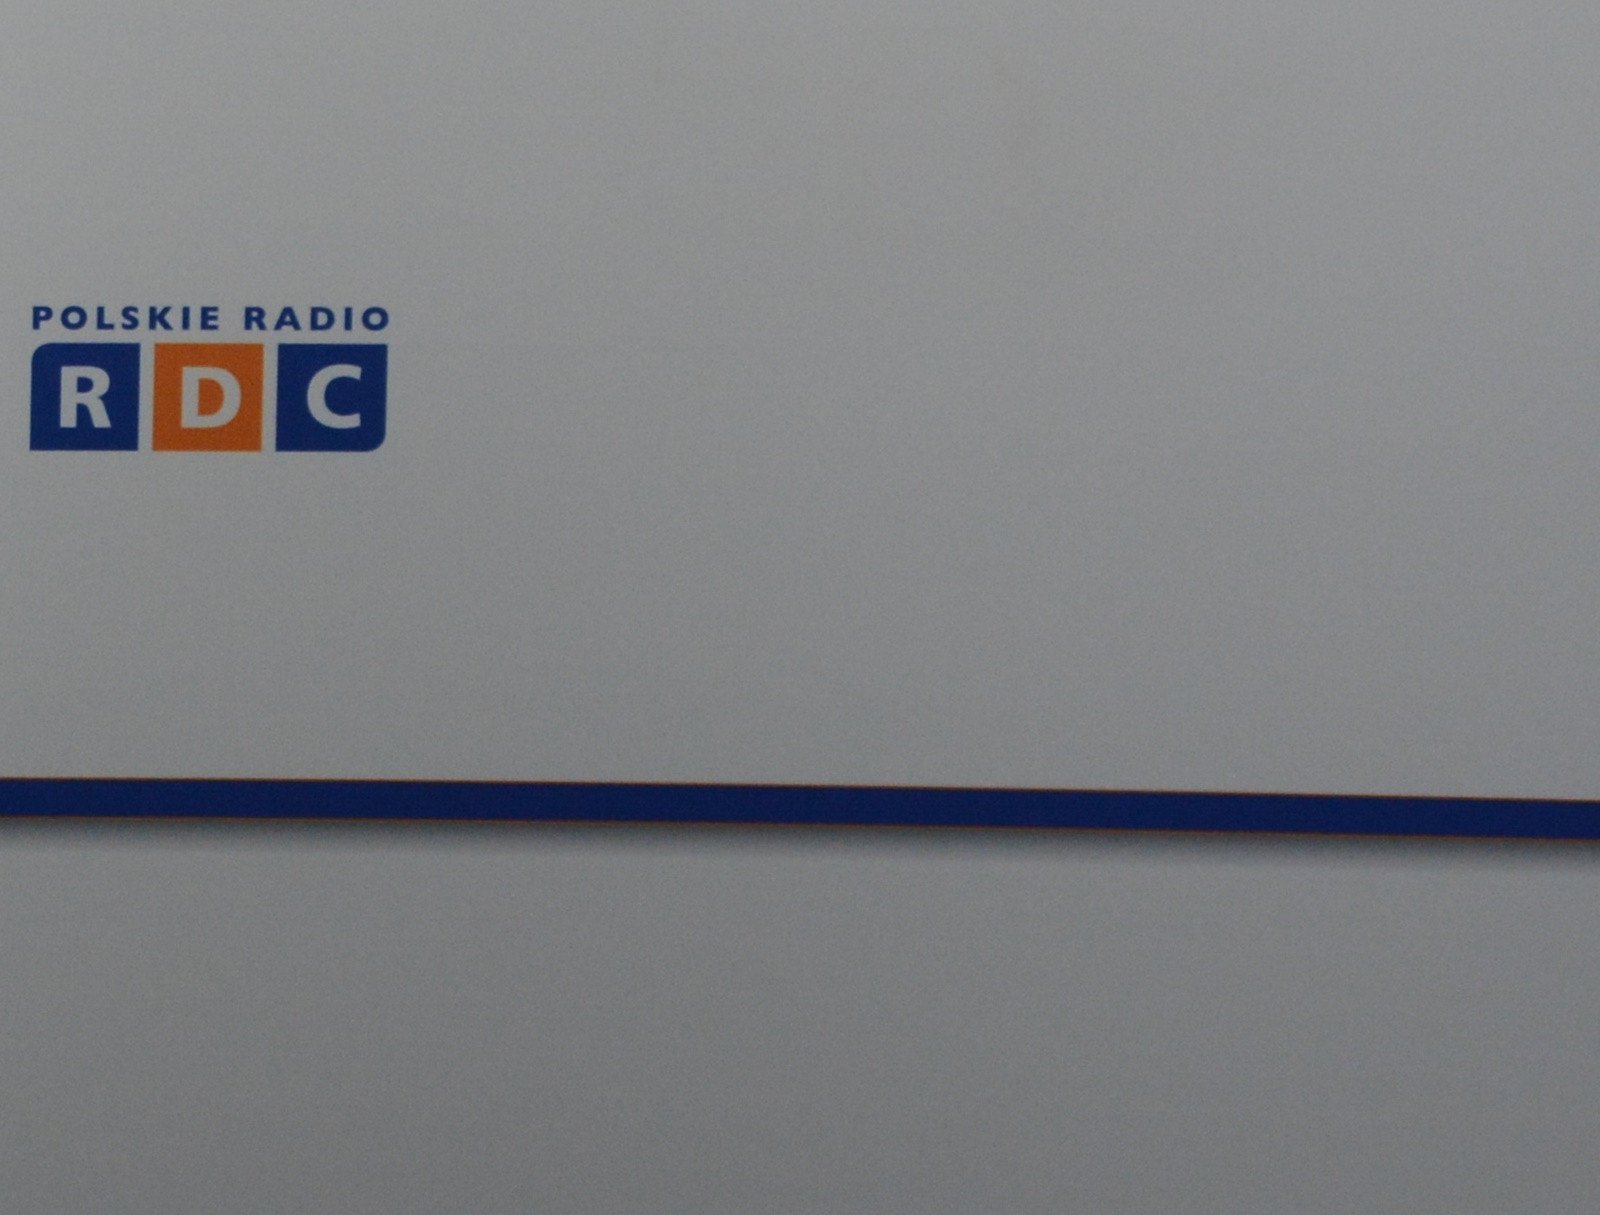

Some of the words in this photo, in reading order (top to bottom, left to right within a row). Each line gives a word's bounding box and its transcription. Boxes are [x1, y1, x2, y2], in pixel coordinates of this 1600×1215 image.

[31, 304, 219, 331] POLSKIE
[243, 305, 391, 332] RADIO
[60, 363, 362, 429] RDC
